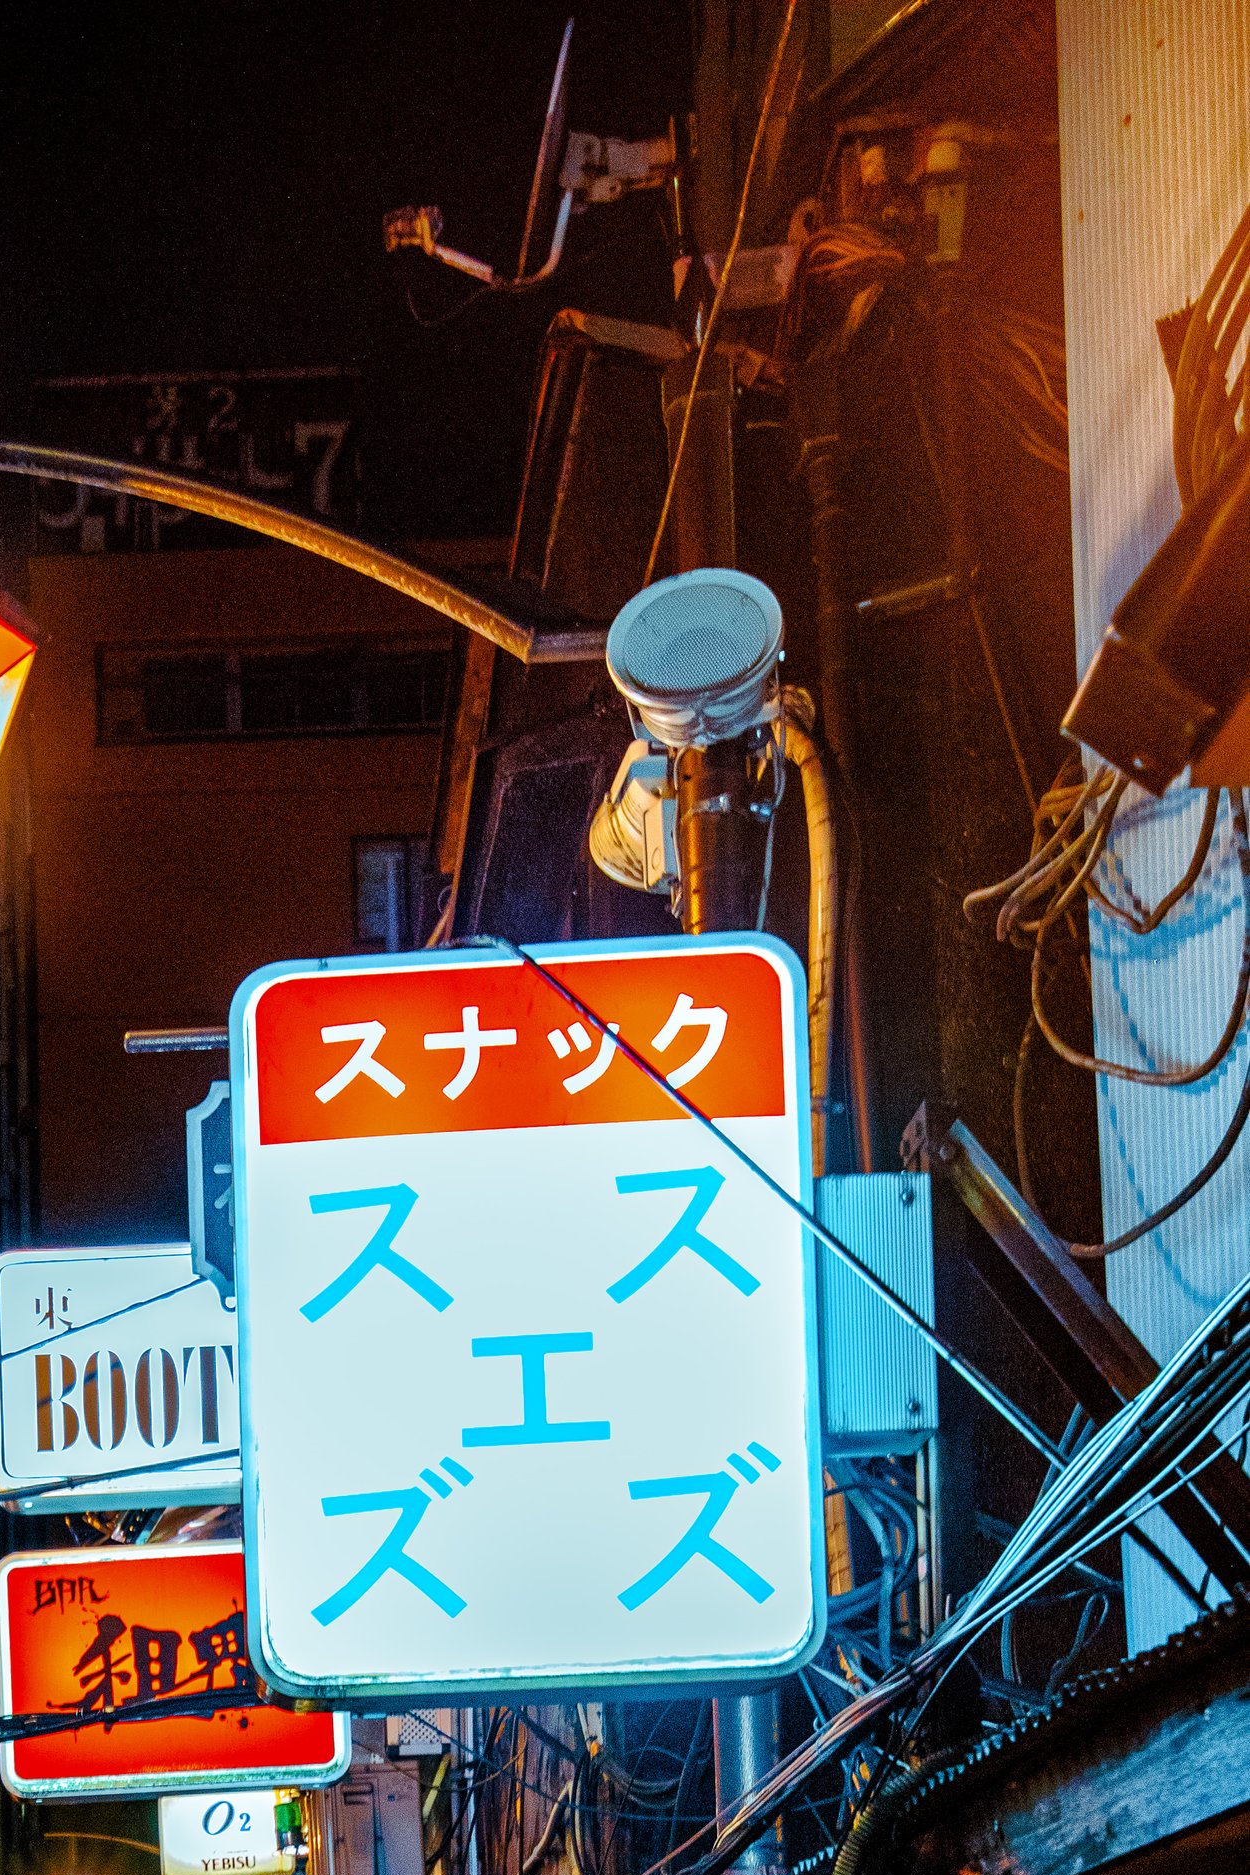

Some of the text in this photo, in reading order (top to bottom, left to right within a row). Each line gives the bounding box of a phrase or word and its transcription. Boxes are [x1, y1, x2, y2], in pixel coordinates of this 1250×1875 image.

[314, 993, 729, 1104] スナック
[26, 1576, 110, 1616] BAR
[201, 1855, 257, 1872] YEBISU
